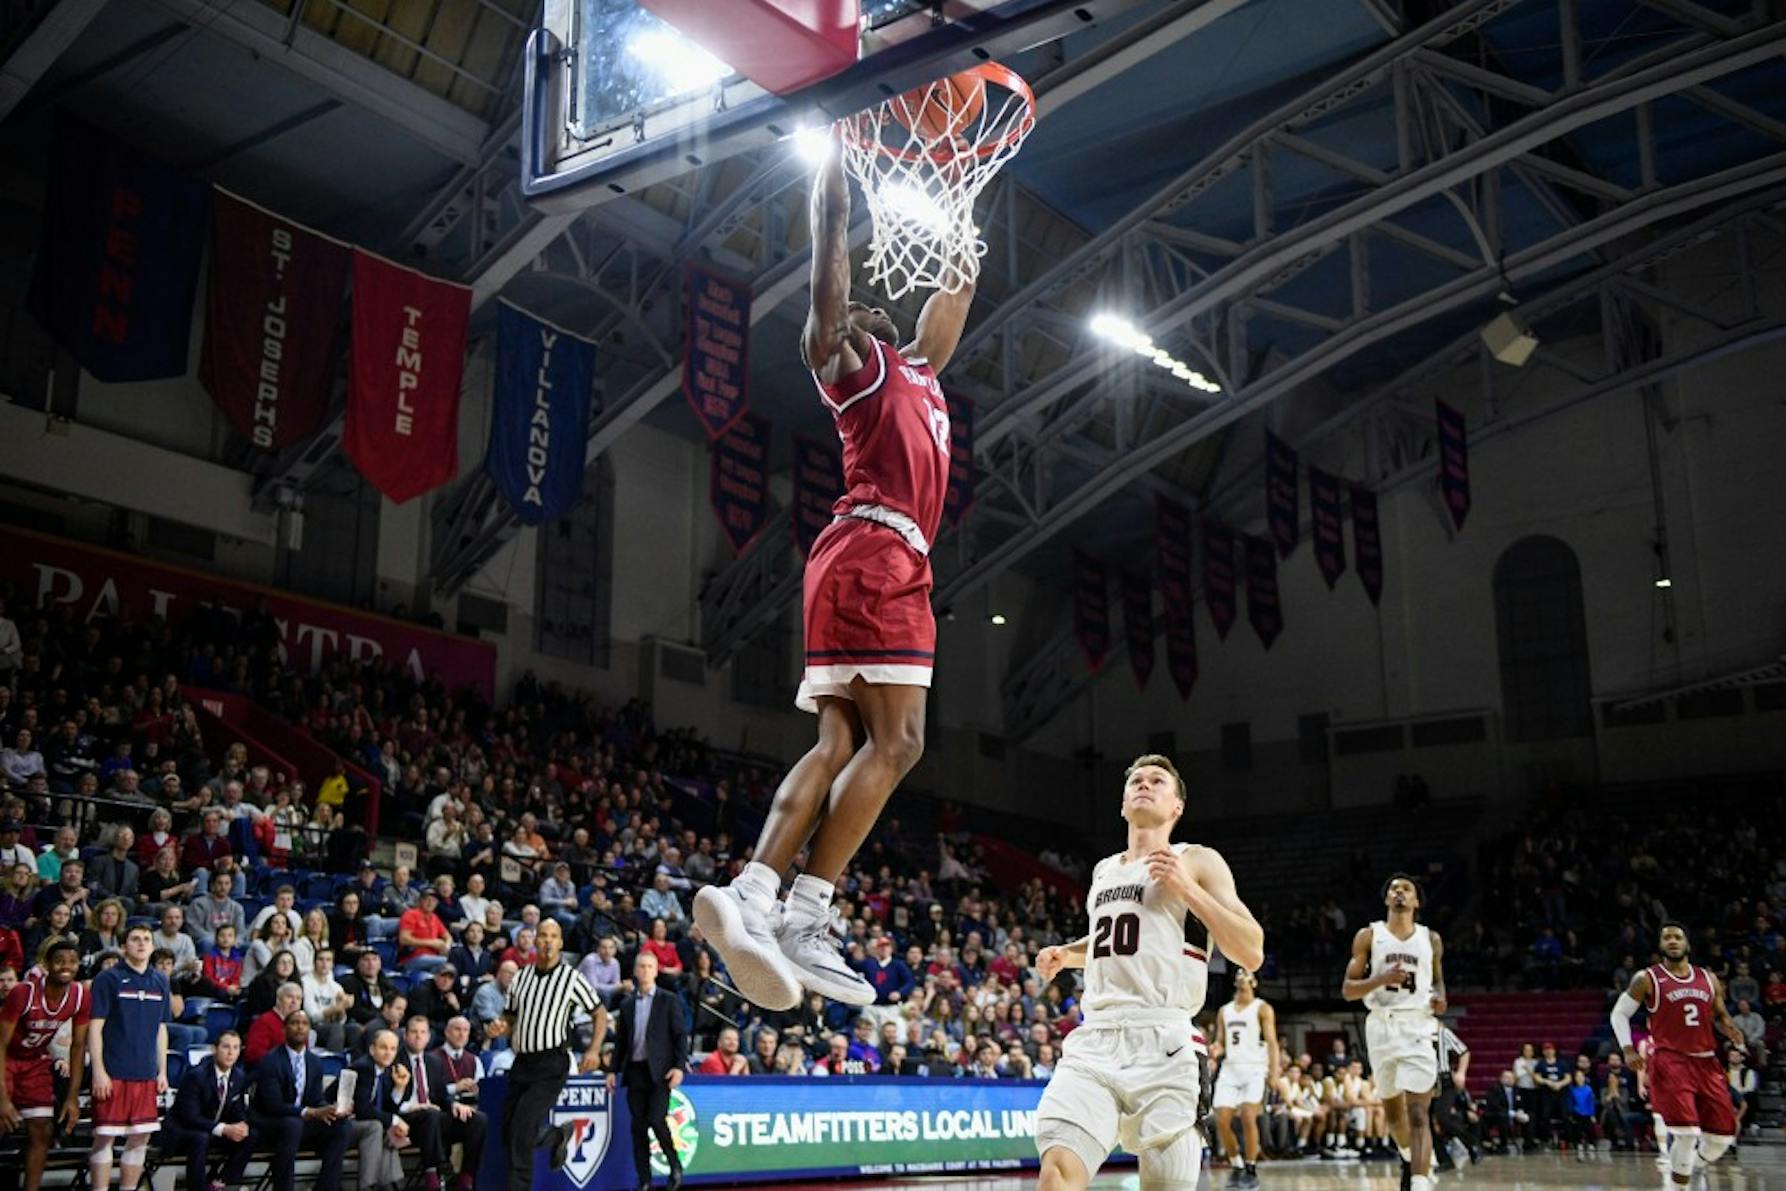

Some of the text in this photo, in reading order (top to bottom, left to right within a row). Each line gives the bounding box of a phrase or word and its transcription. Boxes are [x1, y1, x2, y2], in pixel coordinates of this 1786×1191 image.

[395, 305, 422, 437] TEMPLE
[523, 330, 557, 506] VILLANOVA
[1094, 884, 1145, 907] BROWN
[1093, 912, 1140, 959] 20
[1385, 971, 1416, 994] 4
[1683, 1003, 1700, 1026] 2
[1231, 1031, 1241, 1046] 5
[556, 1087, 607, 1106] PENN
[713, 1110, 919, 1148] STEAMFITTERS
[922, 1109, 1001, 1141] LOCAL
